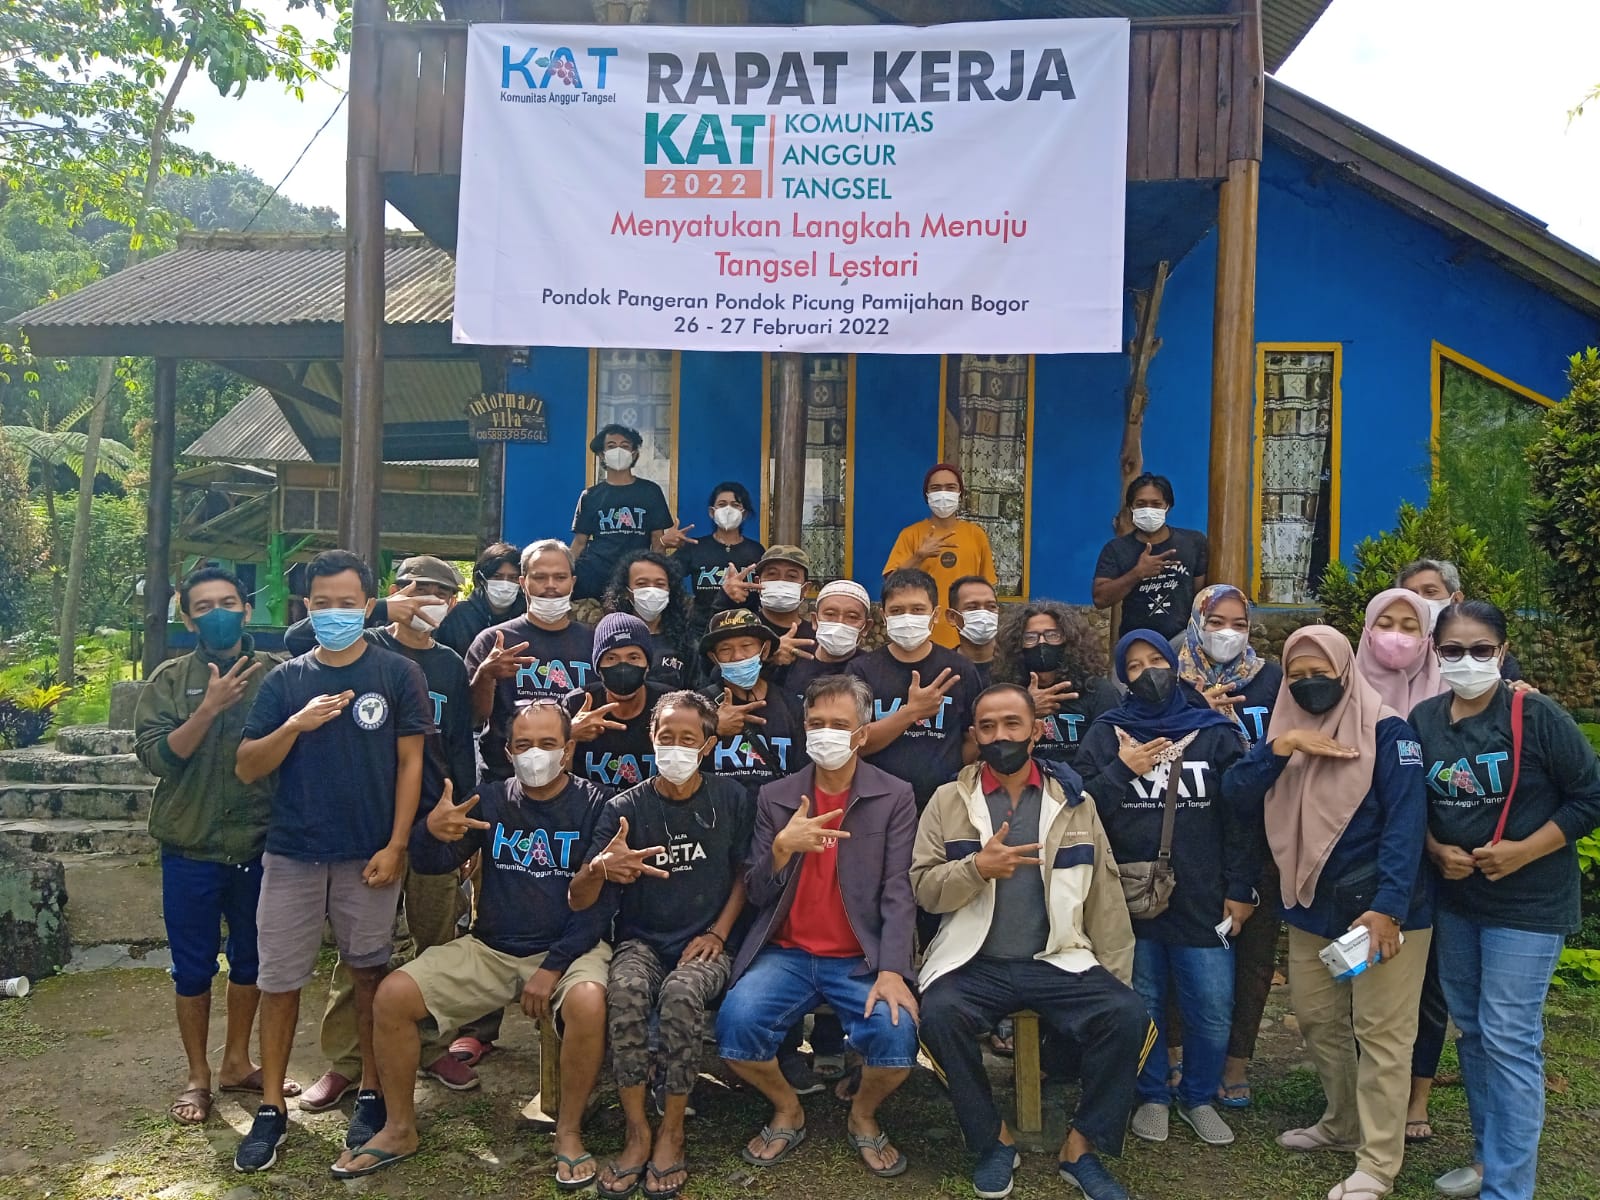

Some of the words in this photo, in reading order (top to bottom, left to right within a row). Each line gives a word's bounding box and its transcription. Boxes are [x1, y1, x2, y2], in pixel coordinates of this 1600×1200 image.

[501, 45, 618, 89] KAT
[647, 50, 848, 105] RAPAT
[872, 48, 1076, 104] KERJA
[501, 91, 546, 103] Komunitas
[549, 91, 580, 105] Anggur
[582, 91, 616, 104] Tangsel
[785, 111, 934, 133] KOMUNITAS
[644, 112, 766, 164] KAT
[782, 144, 896, 166] ANGGUR
[661, 173, 747, 194] 2022
[782, 177, 892, 200] TANGSEL
[611, 210, 781, 243] Menyatukan
[792, 211, 910, 245] Langkah
[921, 210, 1027, 244] Menuju
[714, 250, 817, 283] Tangsel
[829, 252, 918, 278] Lestari
[542, 288, 611, 305] Pondok
[618, 289, 708, 311] Pangeran
[715, 293, 785, 310] Pondok
[792, 293, 854, 313] Picung
[862, 292, 963, 314] Pamijahan
[971, 294, 1030, 315] Bogor
[674, 317, 699, 333] 26
[720, 318, 746, 334] 27
[753, 318, 832, 335] Februari
[839, 318, 889, 335] 2022
[598, 506, 647, 530] KAT
[516, 659, 591, 689] KAT
[874, 696, 953, 729] KT
[1044, 714, 1085, 742] AT
[492, 822, 580, 868] KAT
[495, 861, 527, 872] omunitas
